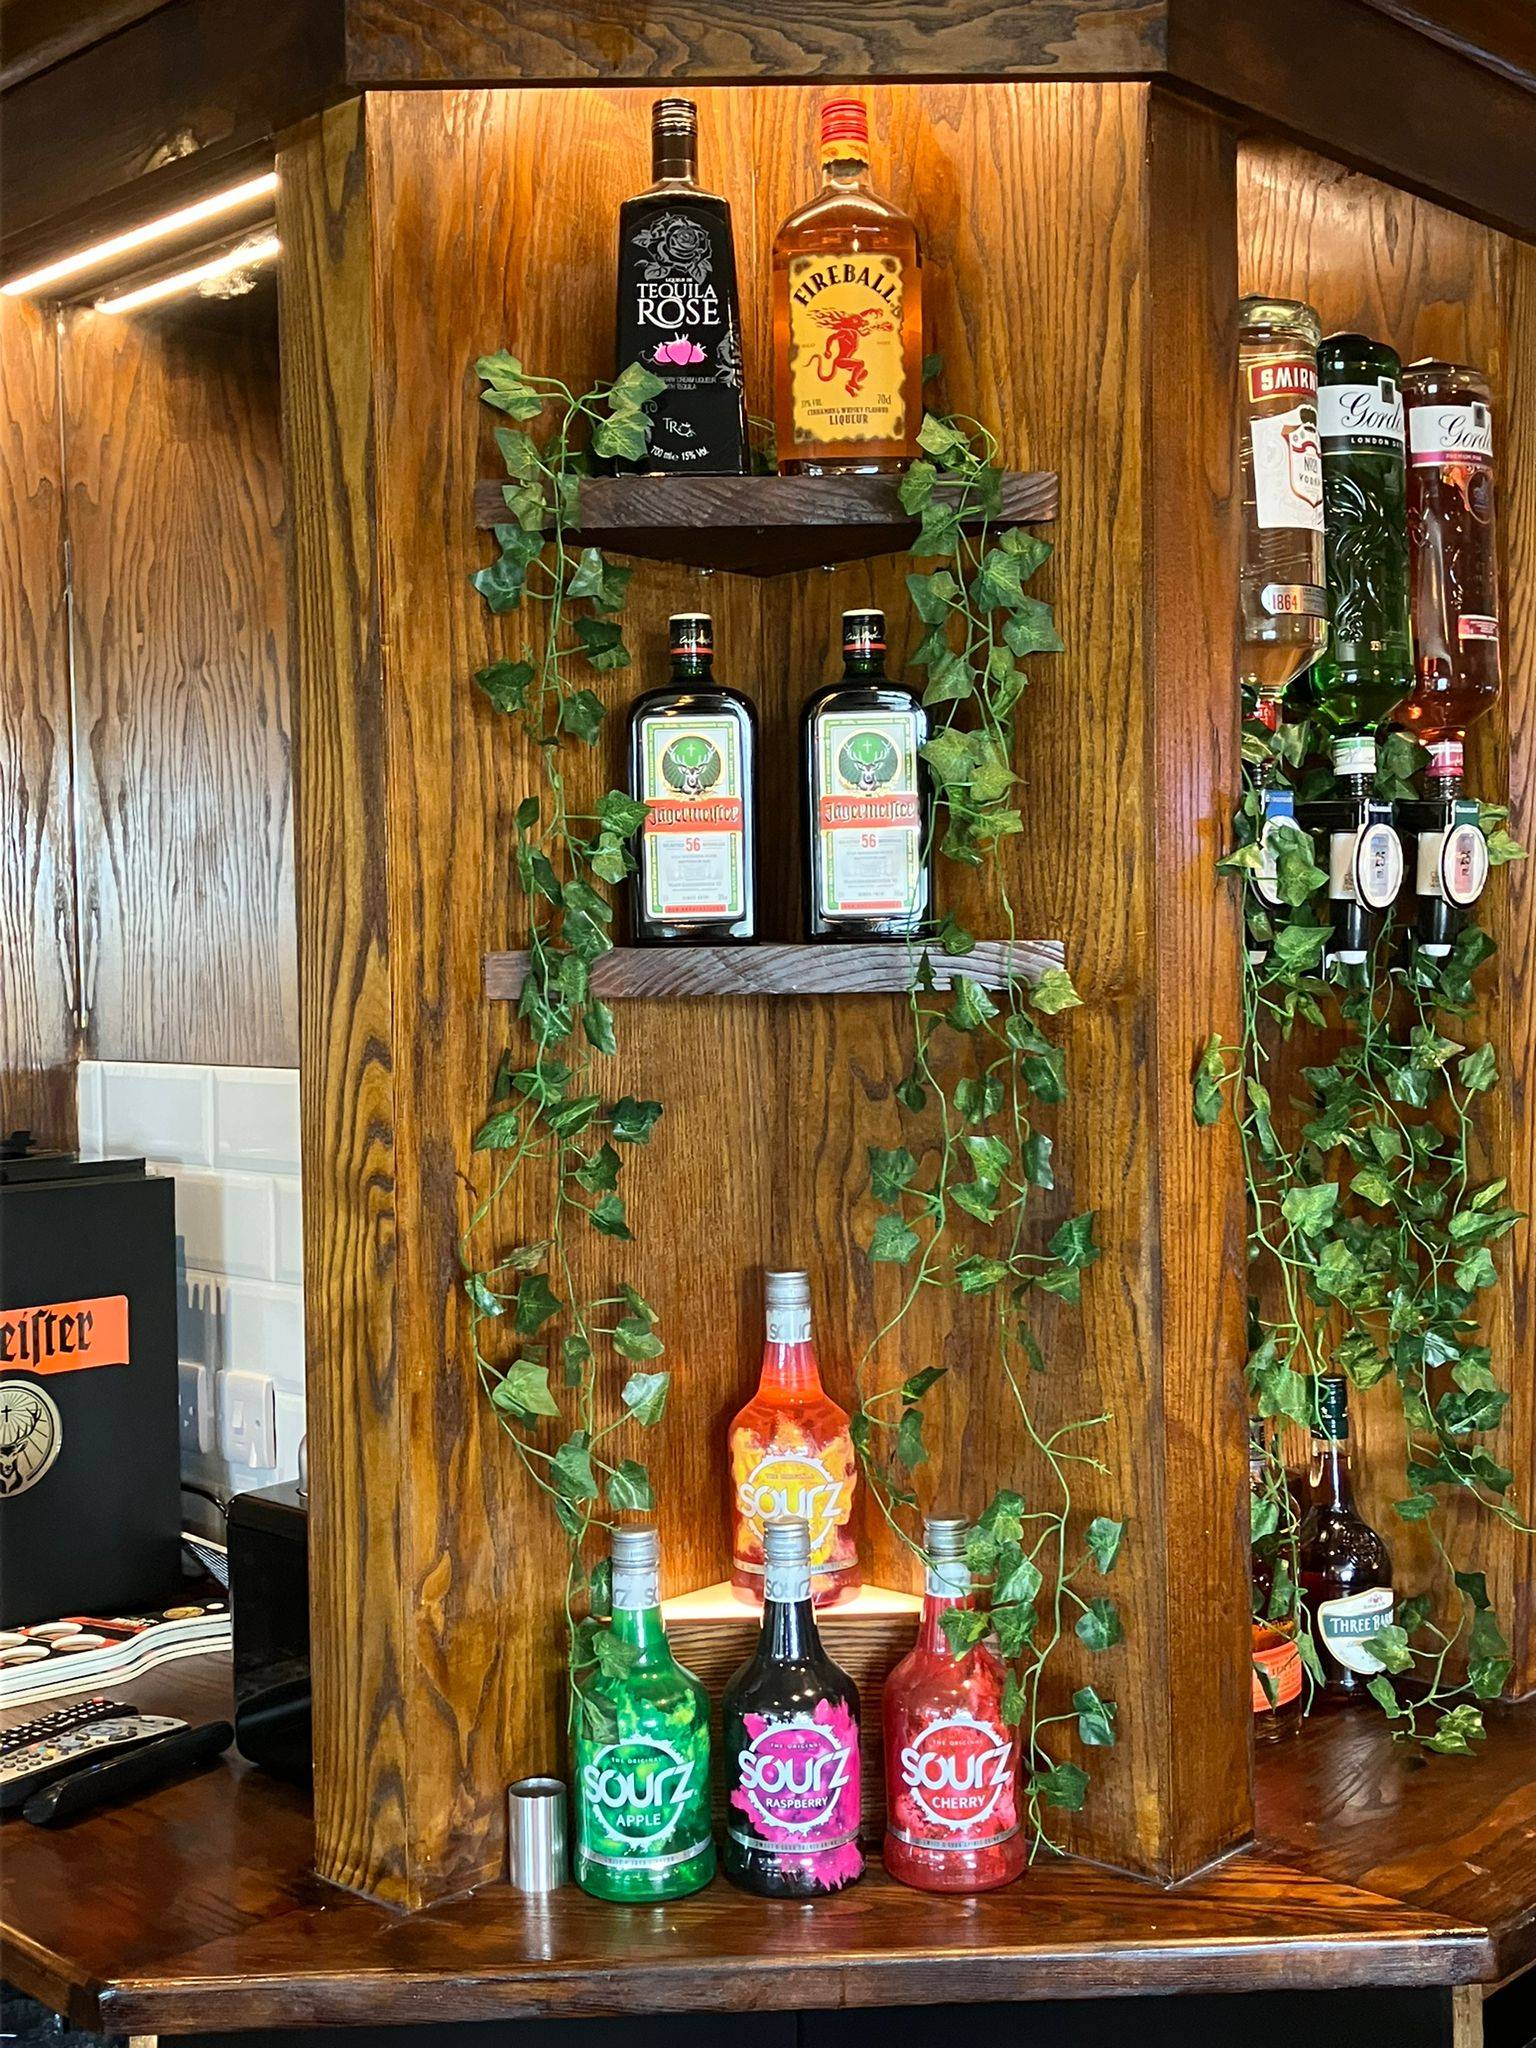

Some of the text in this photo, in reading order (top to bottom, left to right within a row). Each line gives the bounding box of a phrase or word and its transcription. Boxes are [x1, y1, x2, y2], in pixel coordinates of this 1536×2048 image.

[636, 283, 717, 299] TEQUILA
[793, 264, 896, 307] FIREBALL
[636, 298, 721, 329] ROSE
[829, 413, 869, 426] LIQUEUR
[1350, 436, 1389, 446] LONDON
[1272, 593, 1298, 611] 1864
[685, 837, 701, 853] 56
[860, 833, 877, 848] 56
[1329, 1616, 1371, 1635] THREE
[765, 1796, 829, 1809] RASPBERRY
[931, 1795, 986, 1809] CHERRY
[615, 1812, 662, 1828] APPLE
